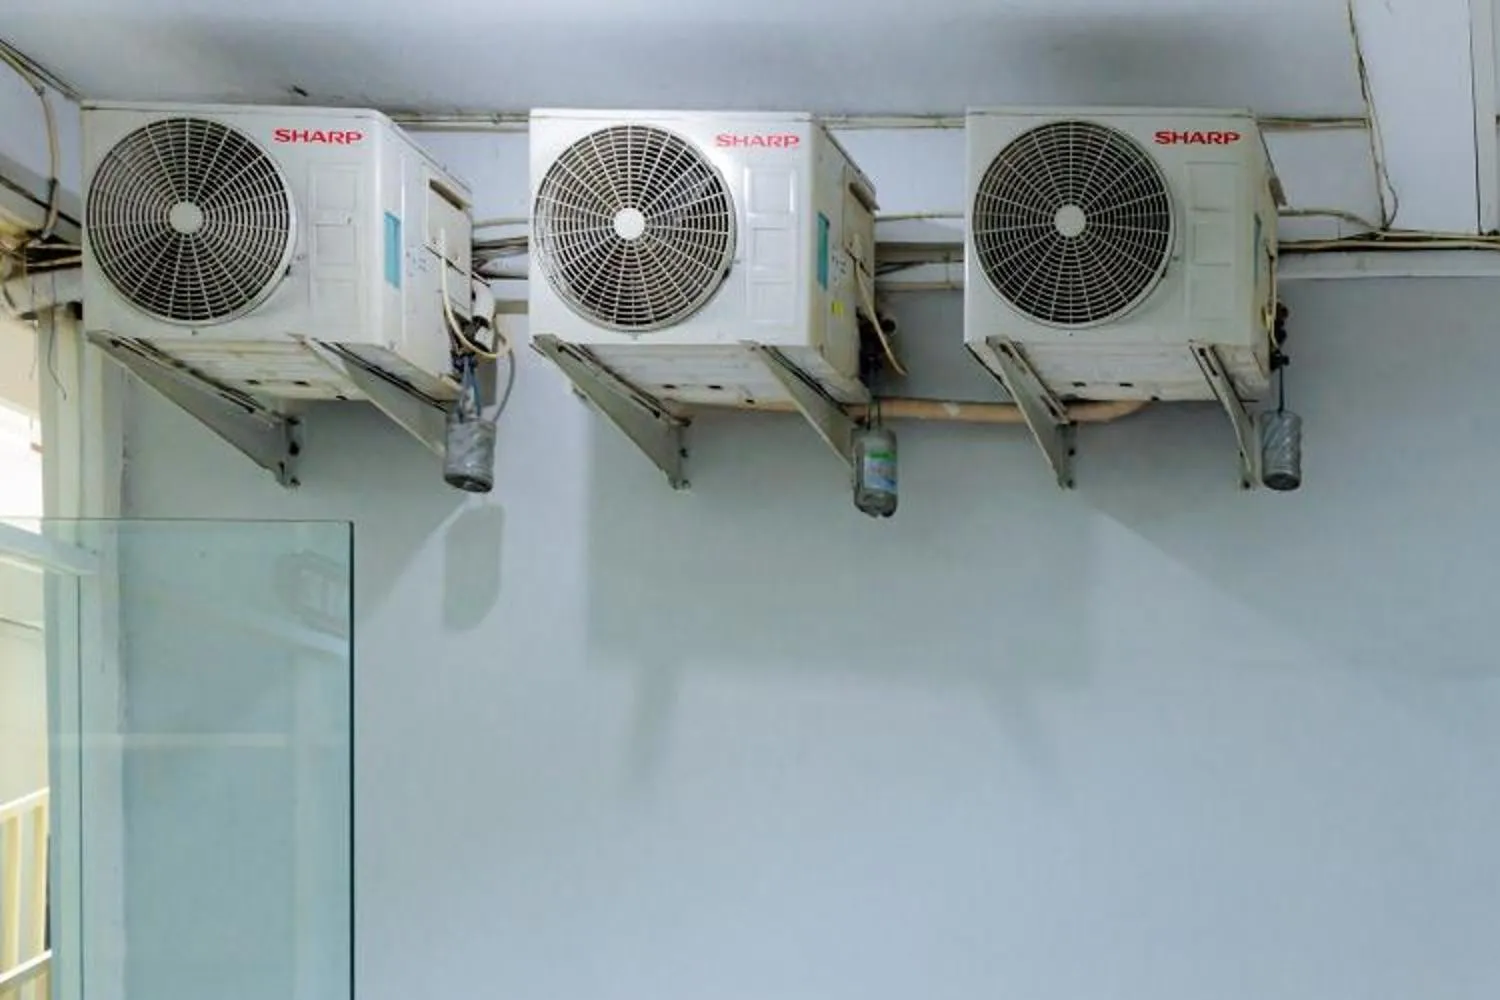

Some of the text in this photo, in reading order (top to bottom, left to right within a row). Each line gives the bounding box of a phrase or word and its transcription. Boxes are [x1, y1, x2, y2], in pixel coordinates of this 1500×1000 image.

[274, 127, 362, 145] SHARP
[715, 134, 800, 148] SHARP
[1155, 130, 1240, 145] SHARP
